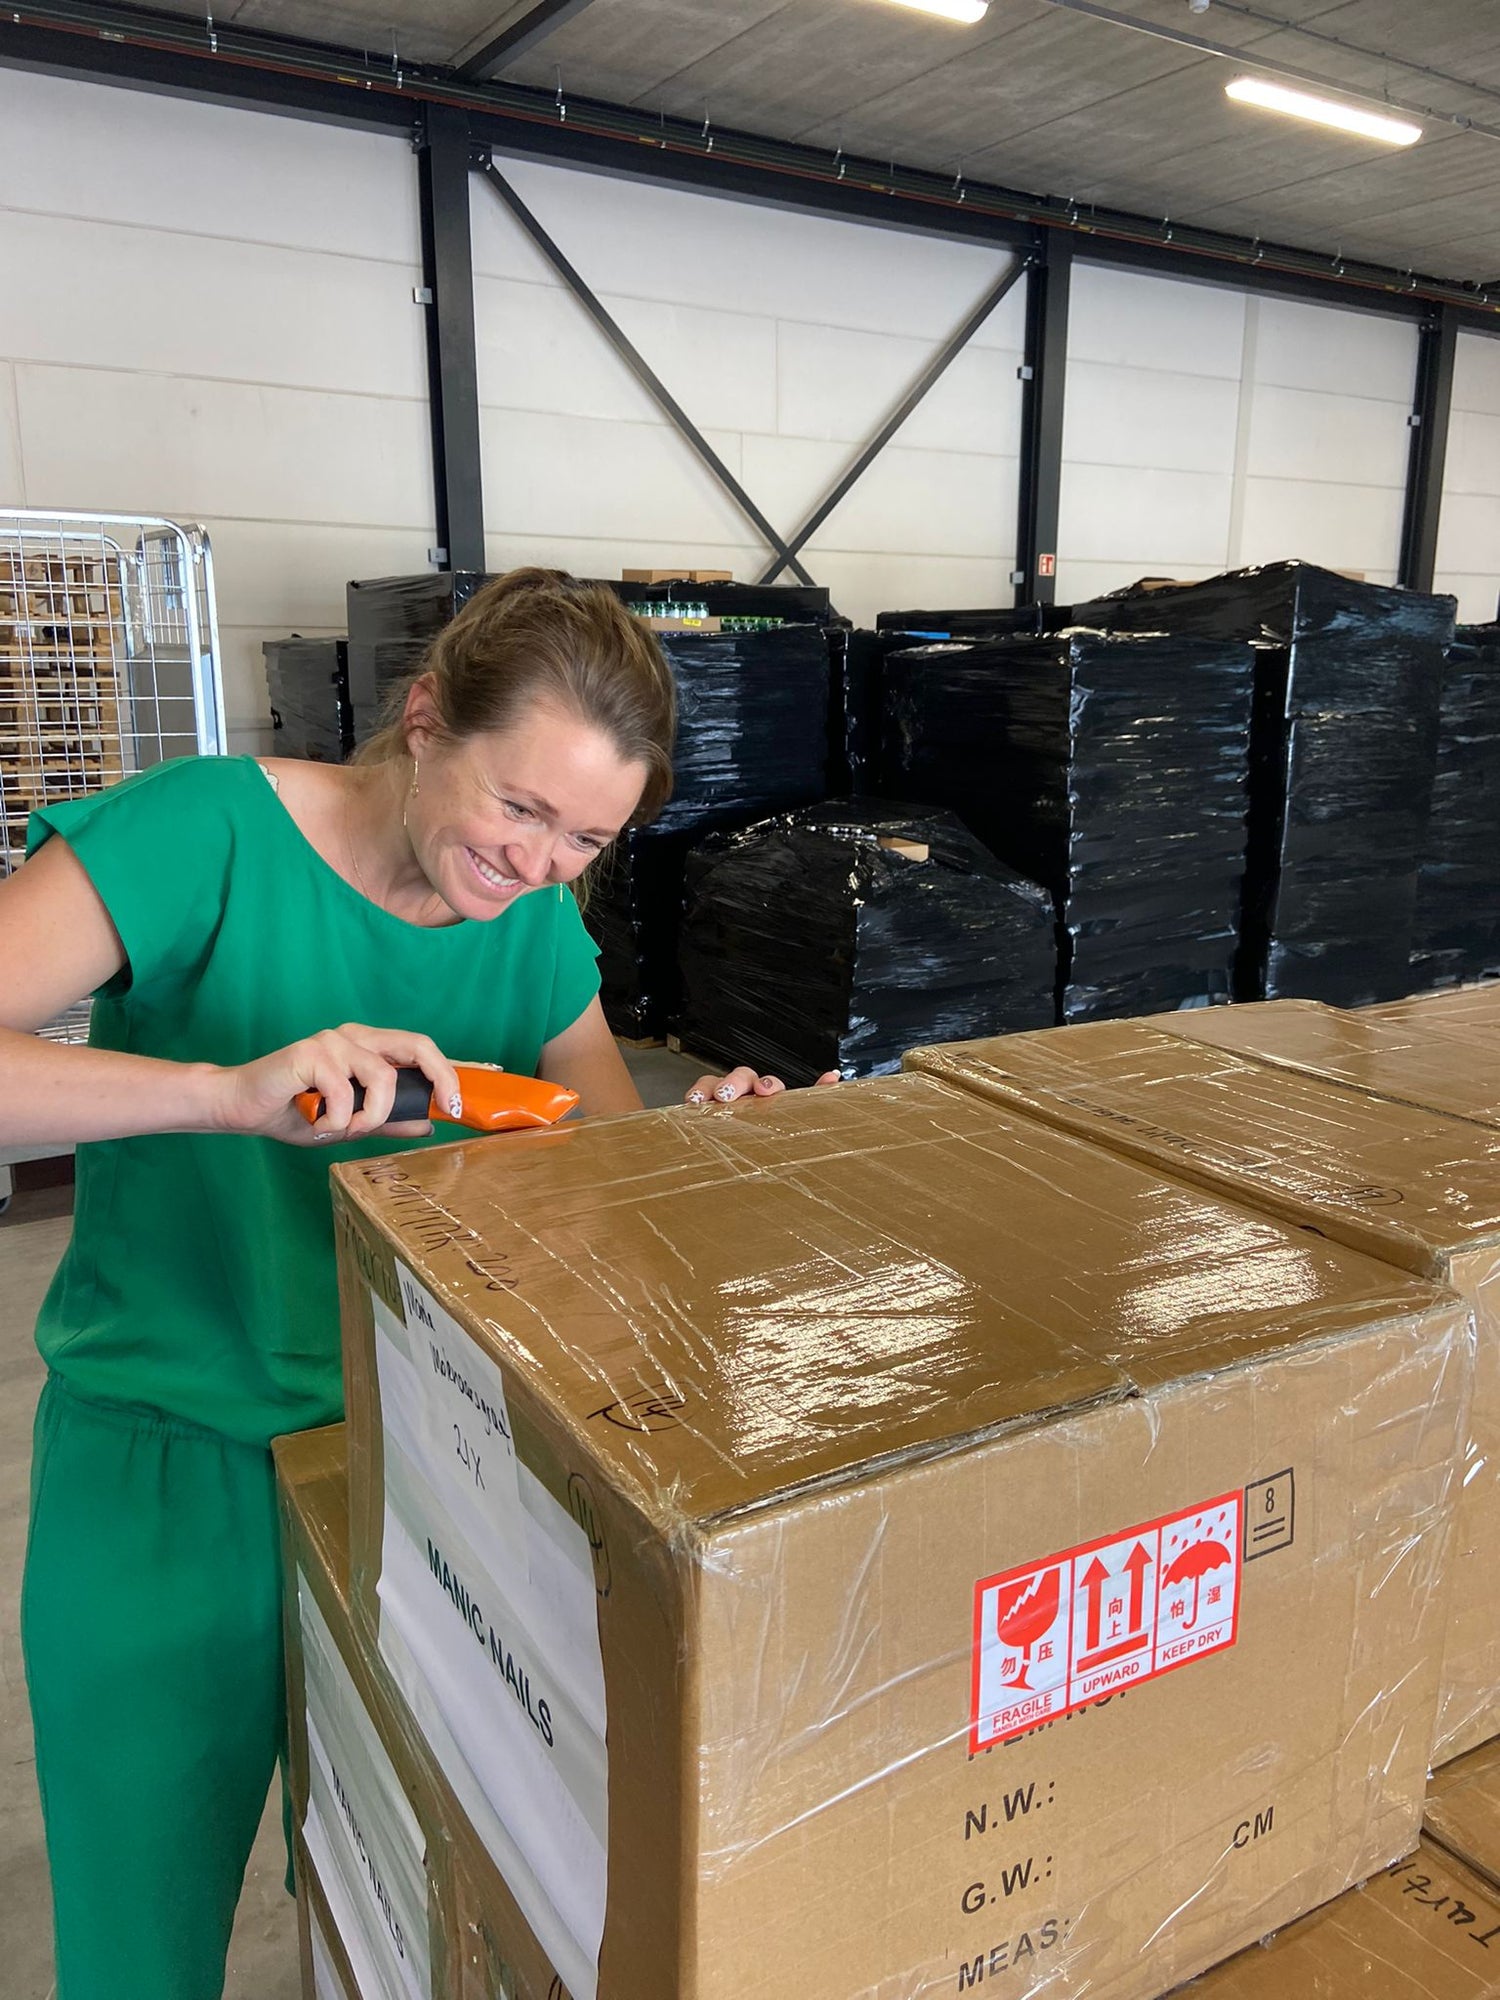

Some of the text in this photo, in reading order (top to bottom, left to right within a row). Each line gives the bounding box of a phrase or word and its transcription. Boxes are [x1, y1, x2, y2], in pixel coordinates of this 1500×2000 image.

[1265, 1487, 1275, 1513] 8
[427, 1537, 554, 1748] MANIC NAILS
[1162, 1627, 1223, 1662] KEEP DRY
[1083, 1661, 1140, 1694] UPWARD
[992, 1693, 1053, 1728] FRAGILE
[965, 1781, 1055, 1840] N.W.:
[1232, 1805, 1274, 1849] CM
[961, 1855, 1053, 1914] G.W.:
[367, 1856, 404, 1959] NAILS
